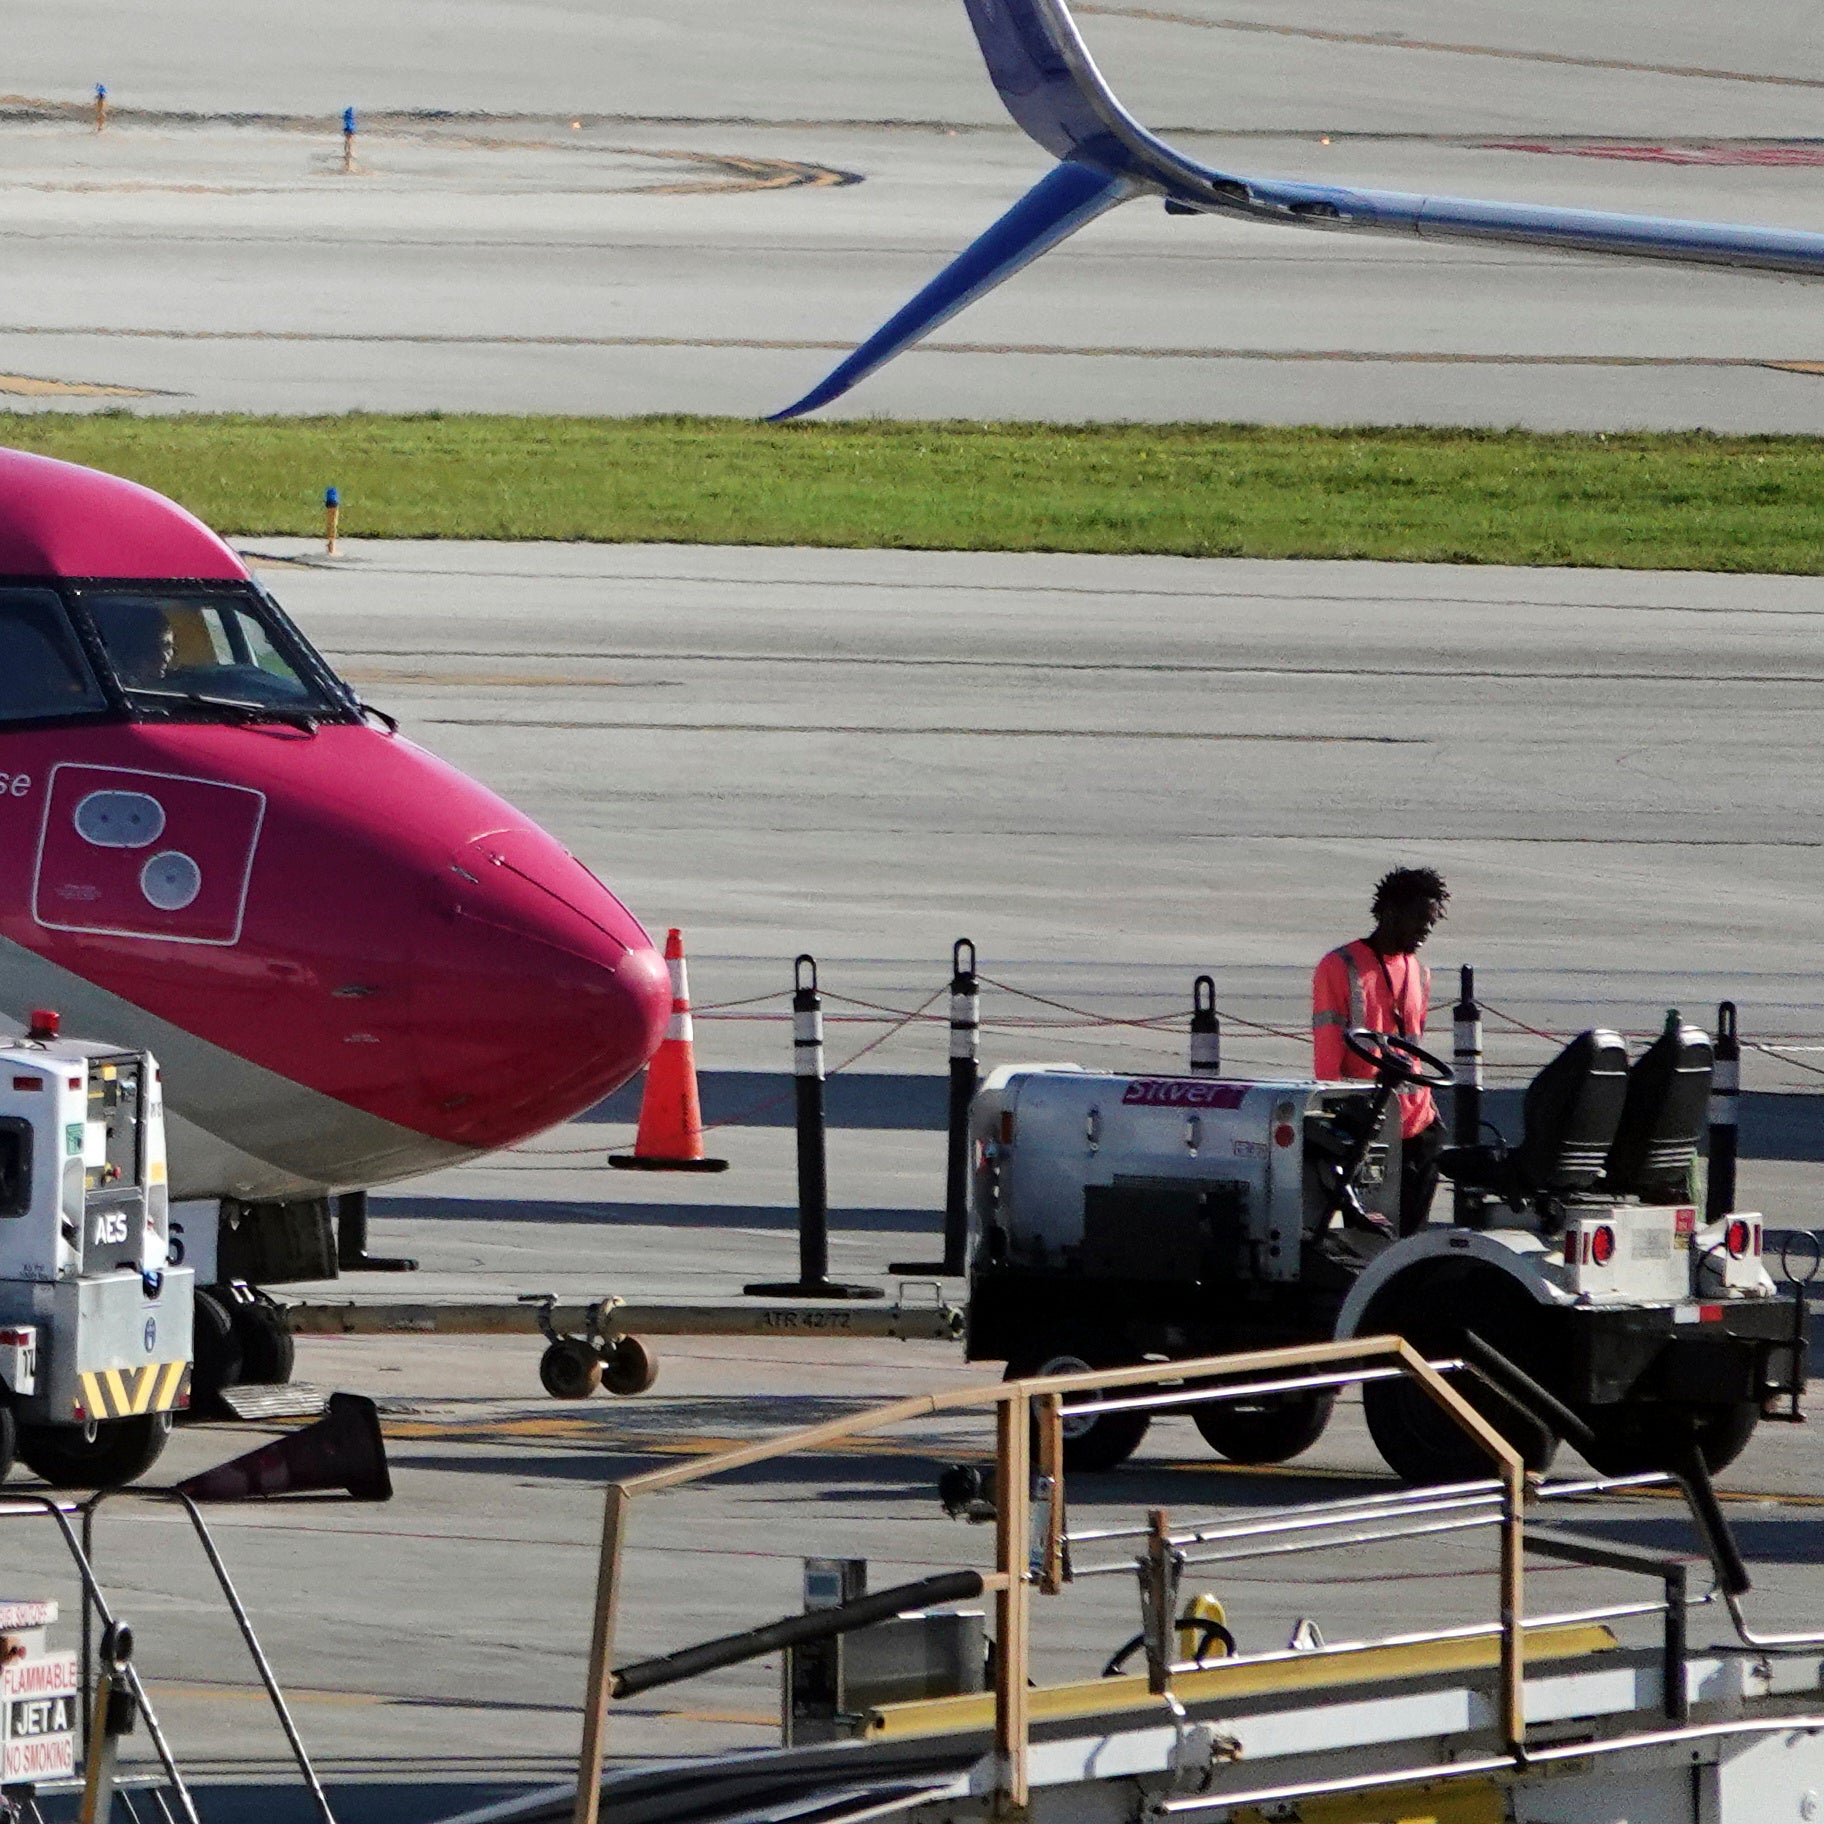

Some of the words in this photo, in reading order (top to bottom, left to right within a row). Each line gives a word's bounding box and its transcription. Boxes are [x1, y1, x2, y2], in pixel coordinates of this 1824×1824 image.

[1125, 1077, 1225, 1103] Silver
[94, 1212, 129, 1246] AES
[4, 1662, 77, 1695] FLAMMABLE
[16, 1702, 52, 1735] JET
[53, 1697, 68, 1731] A
[5, 1745, 21, 1776] NO
[23, 1739, 71, 1773] SMOKING
